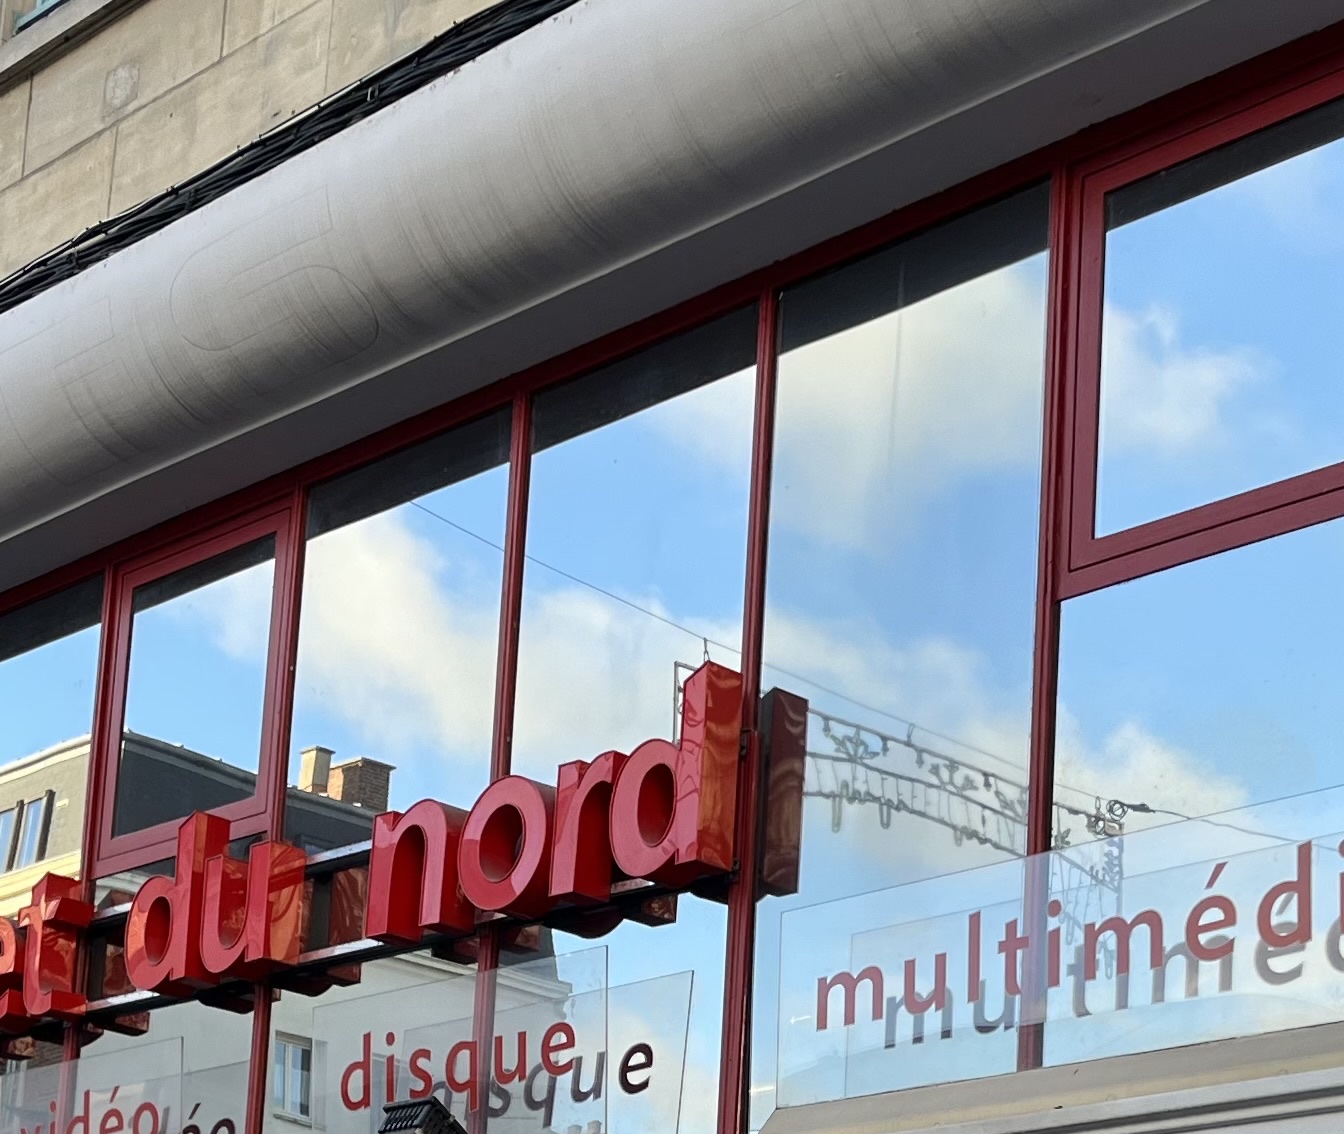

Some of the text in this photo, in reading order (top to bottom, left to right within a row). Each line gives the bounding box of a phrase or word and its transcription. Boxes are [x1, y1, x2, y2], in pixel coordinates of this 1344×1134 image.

[126, 811, 306, 991] du
[366, 660, 744, 947] nord
[340, 1019, 576, 1112] disque
